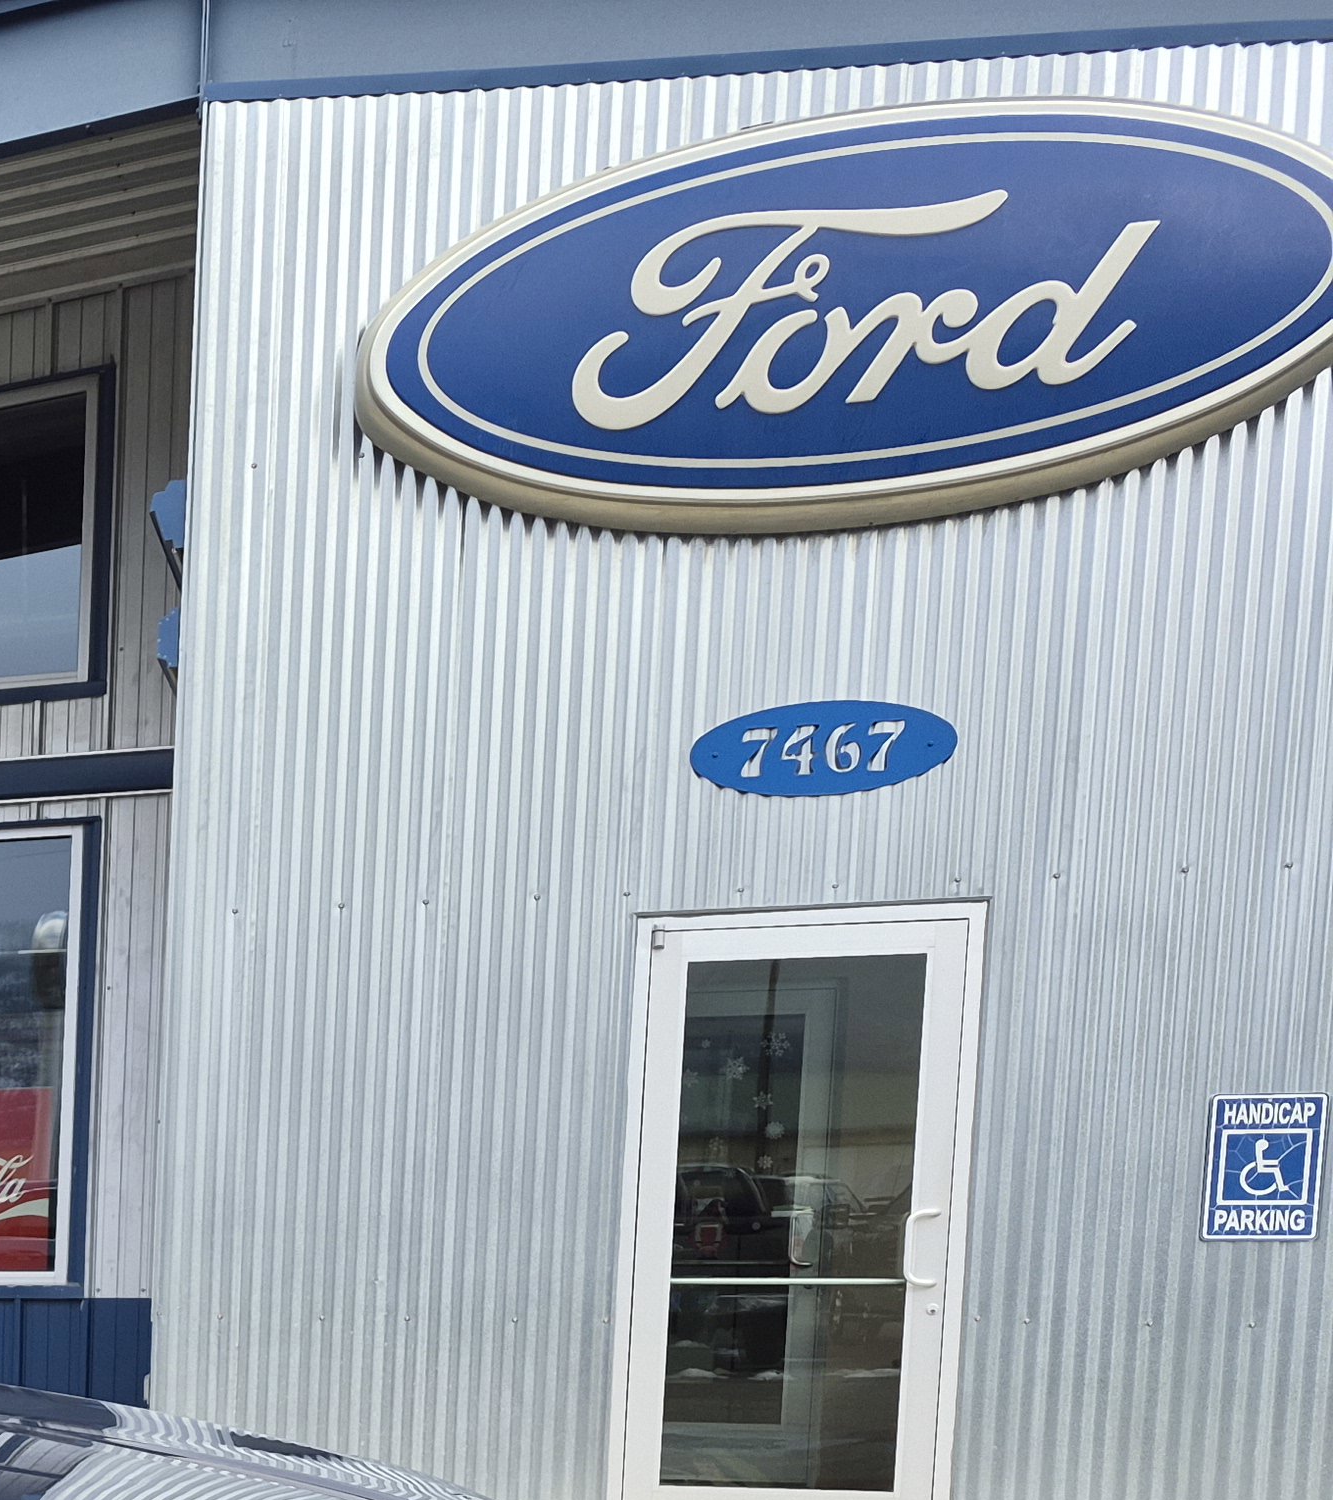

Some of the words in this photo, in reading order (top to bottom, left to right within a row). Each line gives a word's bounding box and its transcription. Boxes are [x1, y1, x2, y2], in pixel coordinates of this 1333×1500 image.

[572, 188, 1160, 430] Ford
[739, 720, 906, 778] 7467
[1224, 1102, 1316, 1125] HANDICAP
[1214, 1208, 1306, 1232] PARKING
